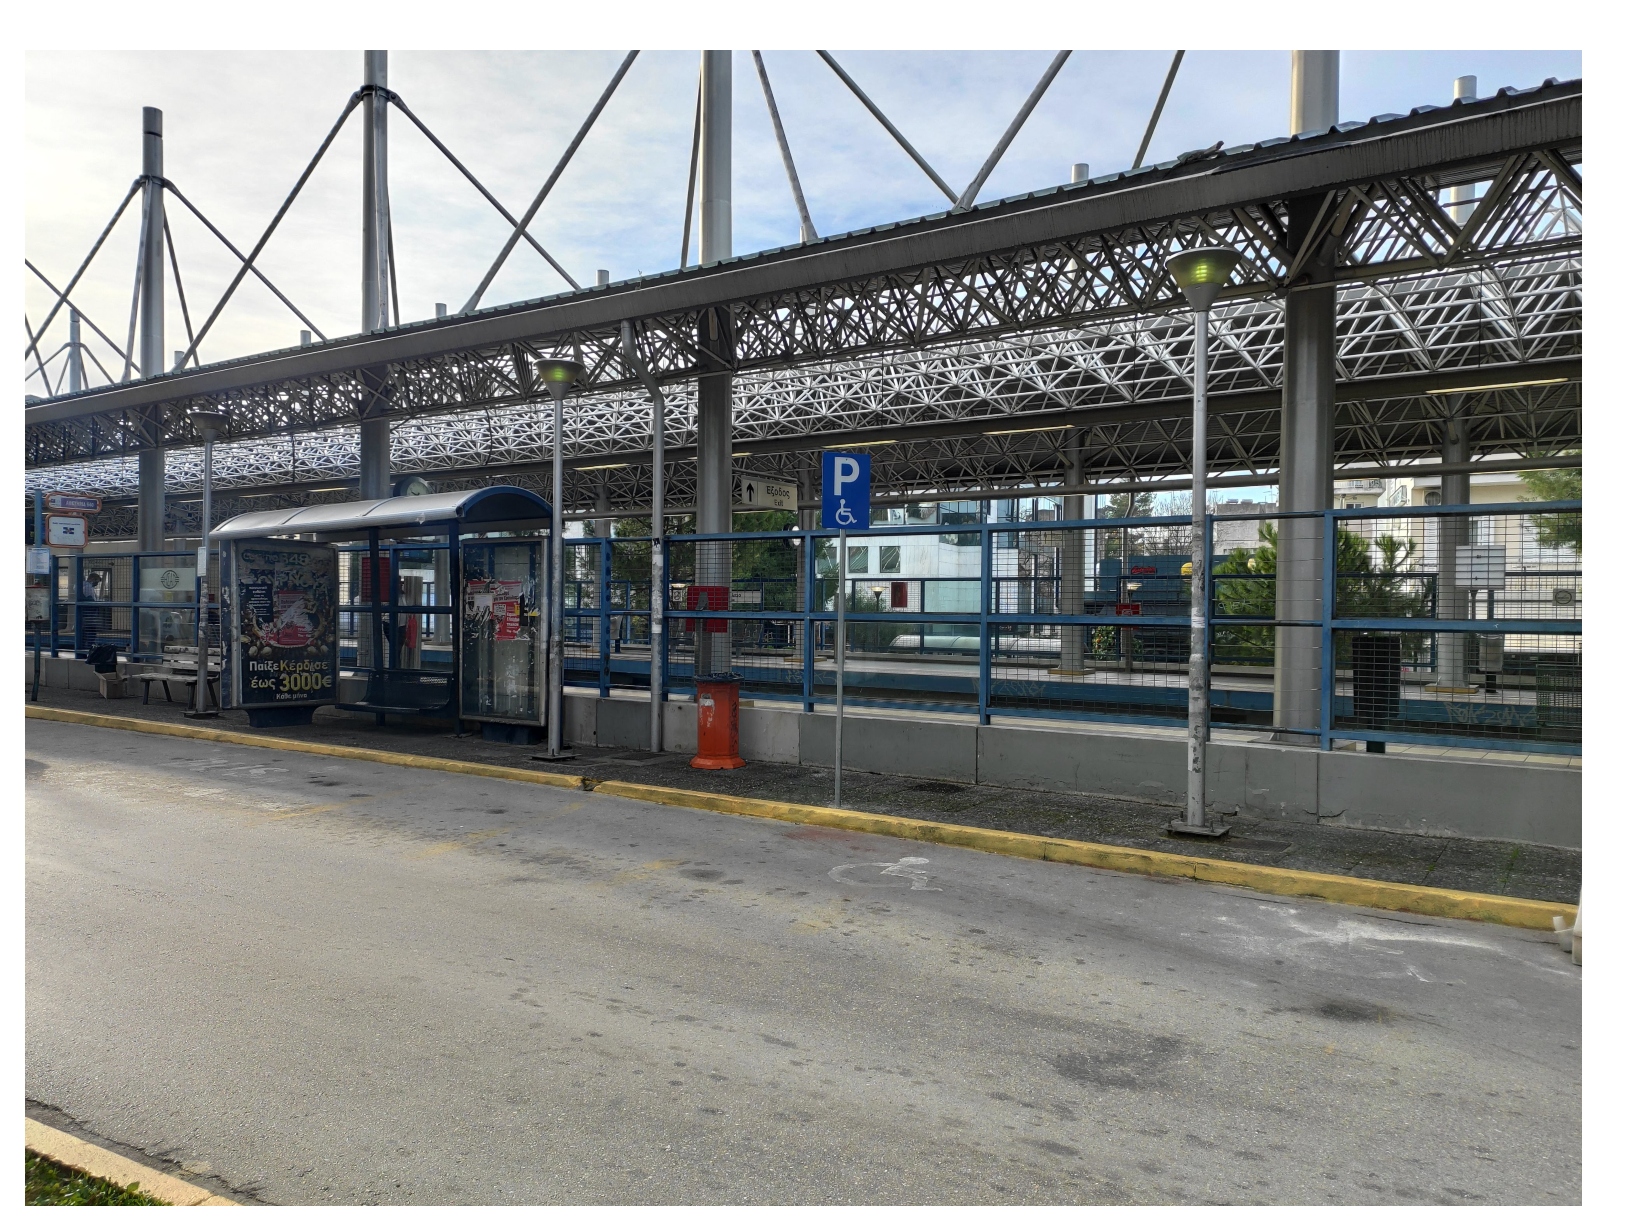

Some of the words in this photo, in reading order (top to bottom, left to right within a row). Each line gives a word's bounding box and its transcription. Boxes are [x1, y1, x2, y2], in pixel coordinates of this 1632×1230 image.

[834, 456, 860, 496] P
[249, 660, 279, 673] Παίξε
[279, 673, 332, 692] 3000€
